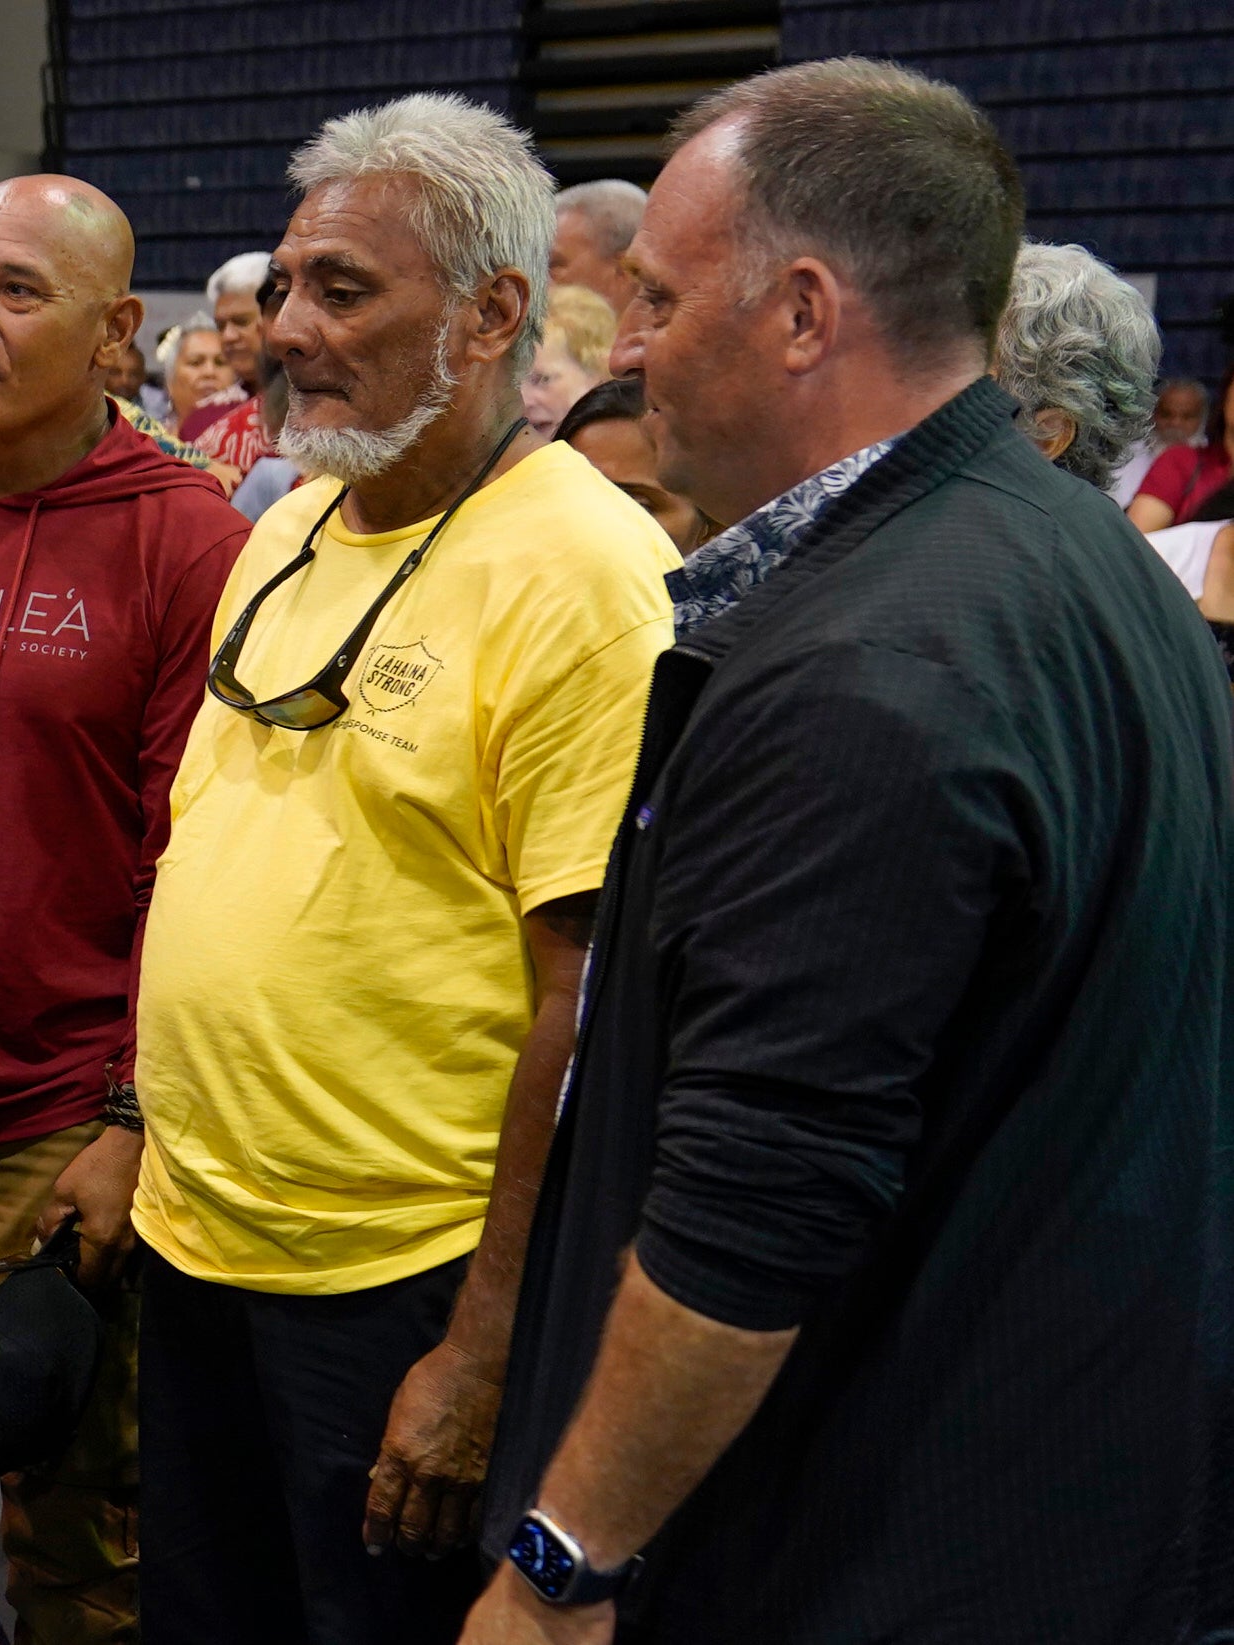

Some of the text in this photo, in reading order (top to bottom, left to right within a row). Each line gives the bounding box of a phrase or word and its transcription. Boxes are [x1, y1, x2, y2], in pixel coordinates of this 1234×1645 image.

[19, 641, 89, 661] SOCIETY
[366, 670, 416, 697] STRONG
[390, 736, 420, 754] TEAM
